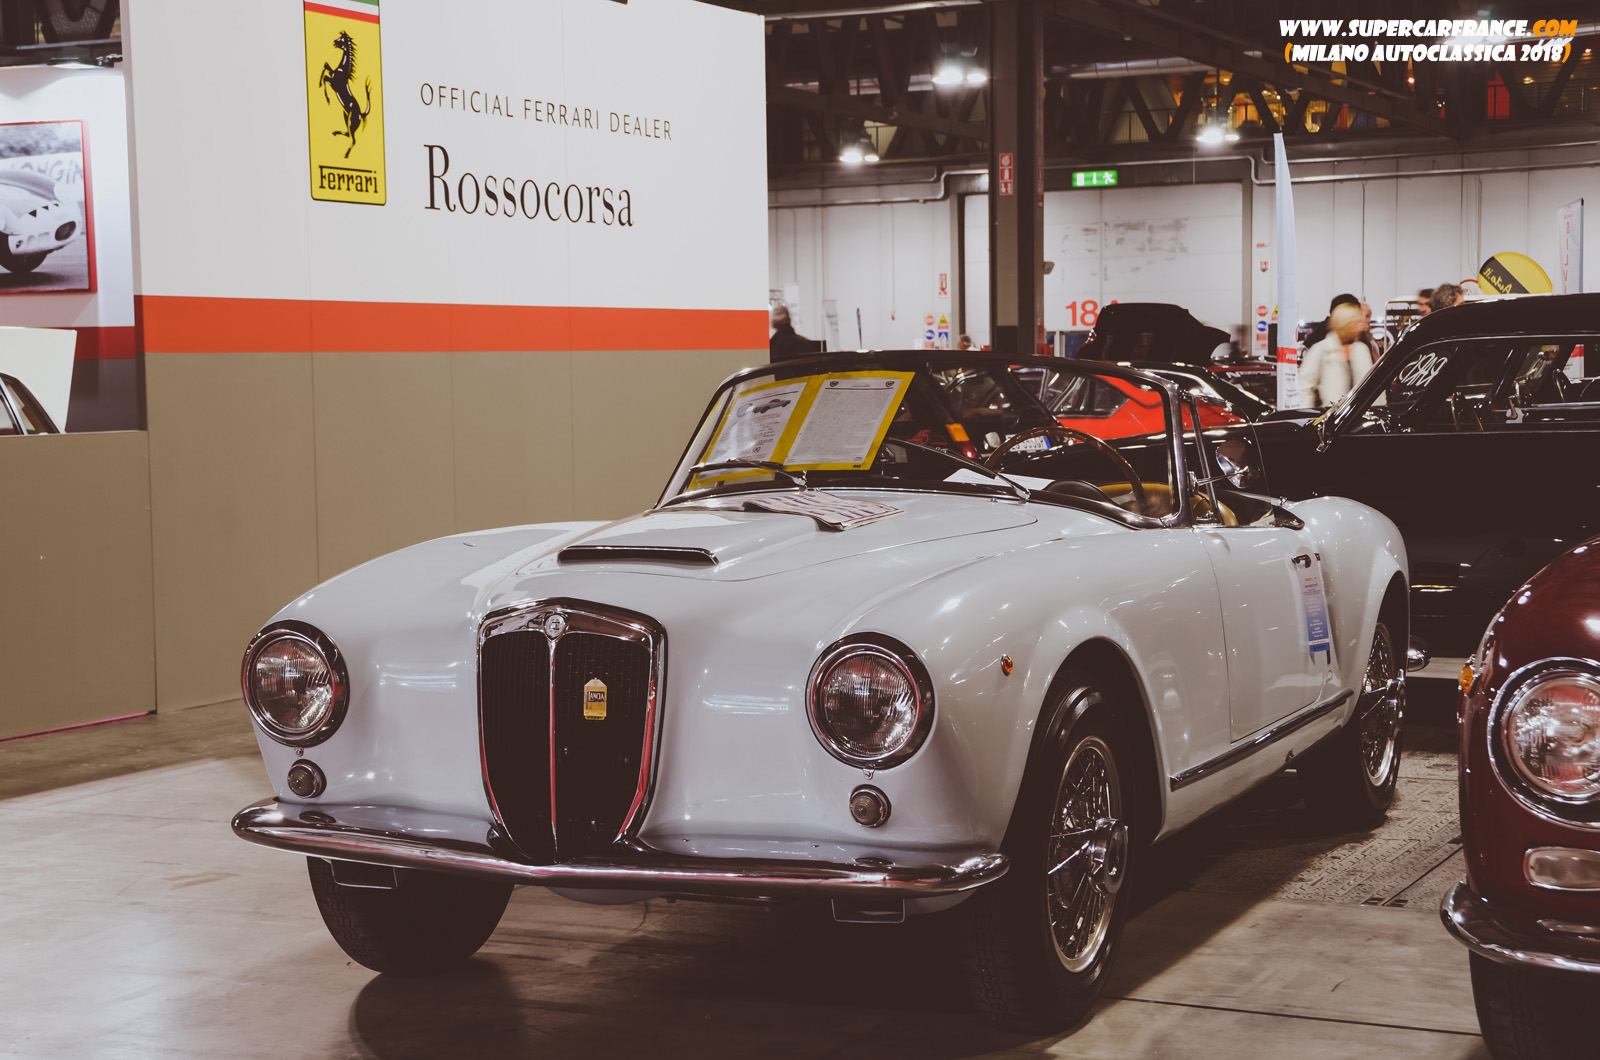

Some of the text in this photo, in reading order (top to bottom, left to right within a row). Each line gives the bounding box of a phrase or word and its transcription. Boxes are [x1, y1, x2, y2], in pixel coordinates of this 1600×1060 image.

[420, 82, 674, 141] OFFICIAL FERRARI DEALER
[318, 164, 379, 194] Ferrari
[423, 143, 635, 228] Rossocorsa
[1065, 299, 1118, 327] 18
[588, 691, 605, 702] LANCIA
